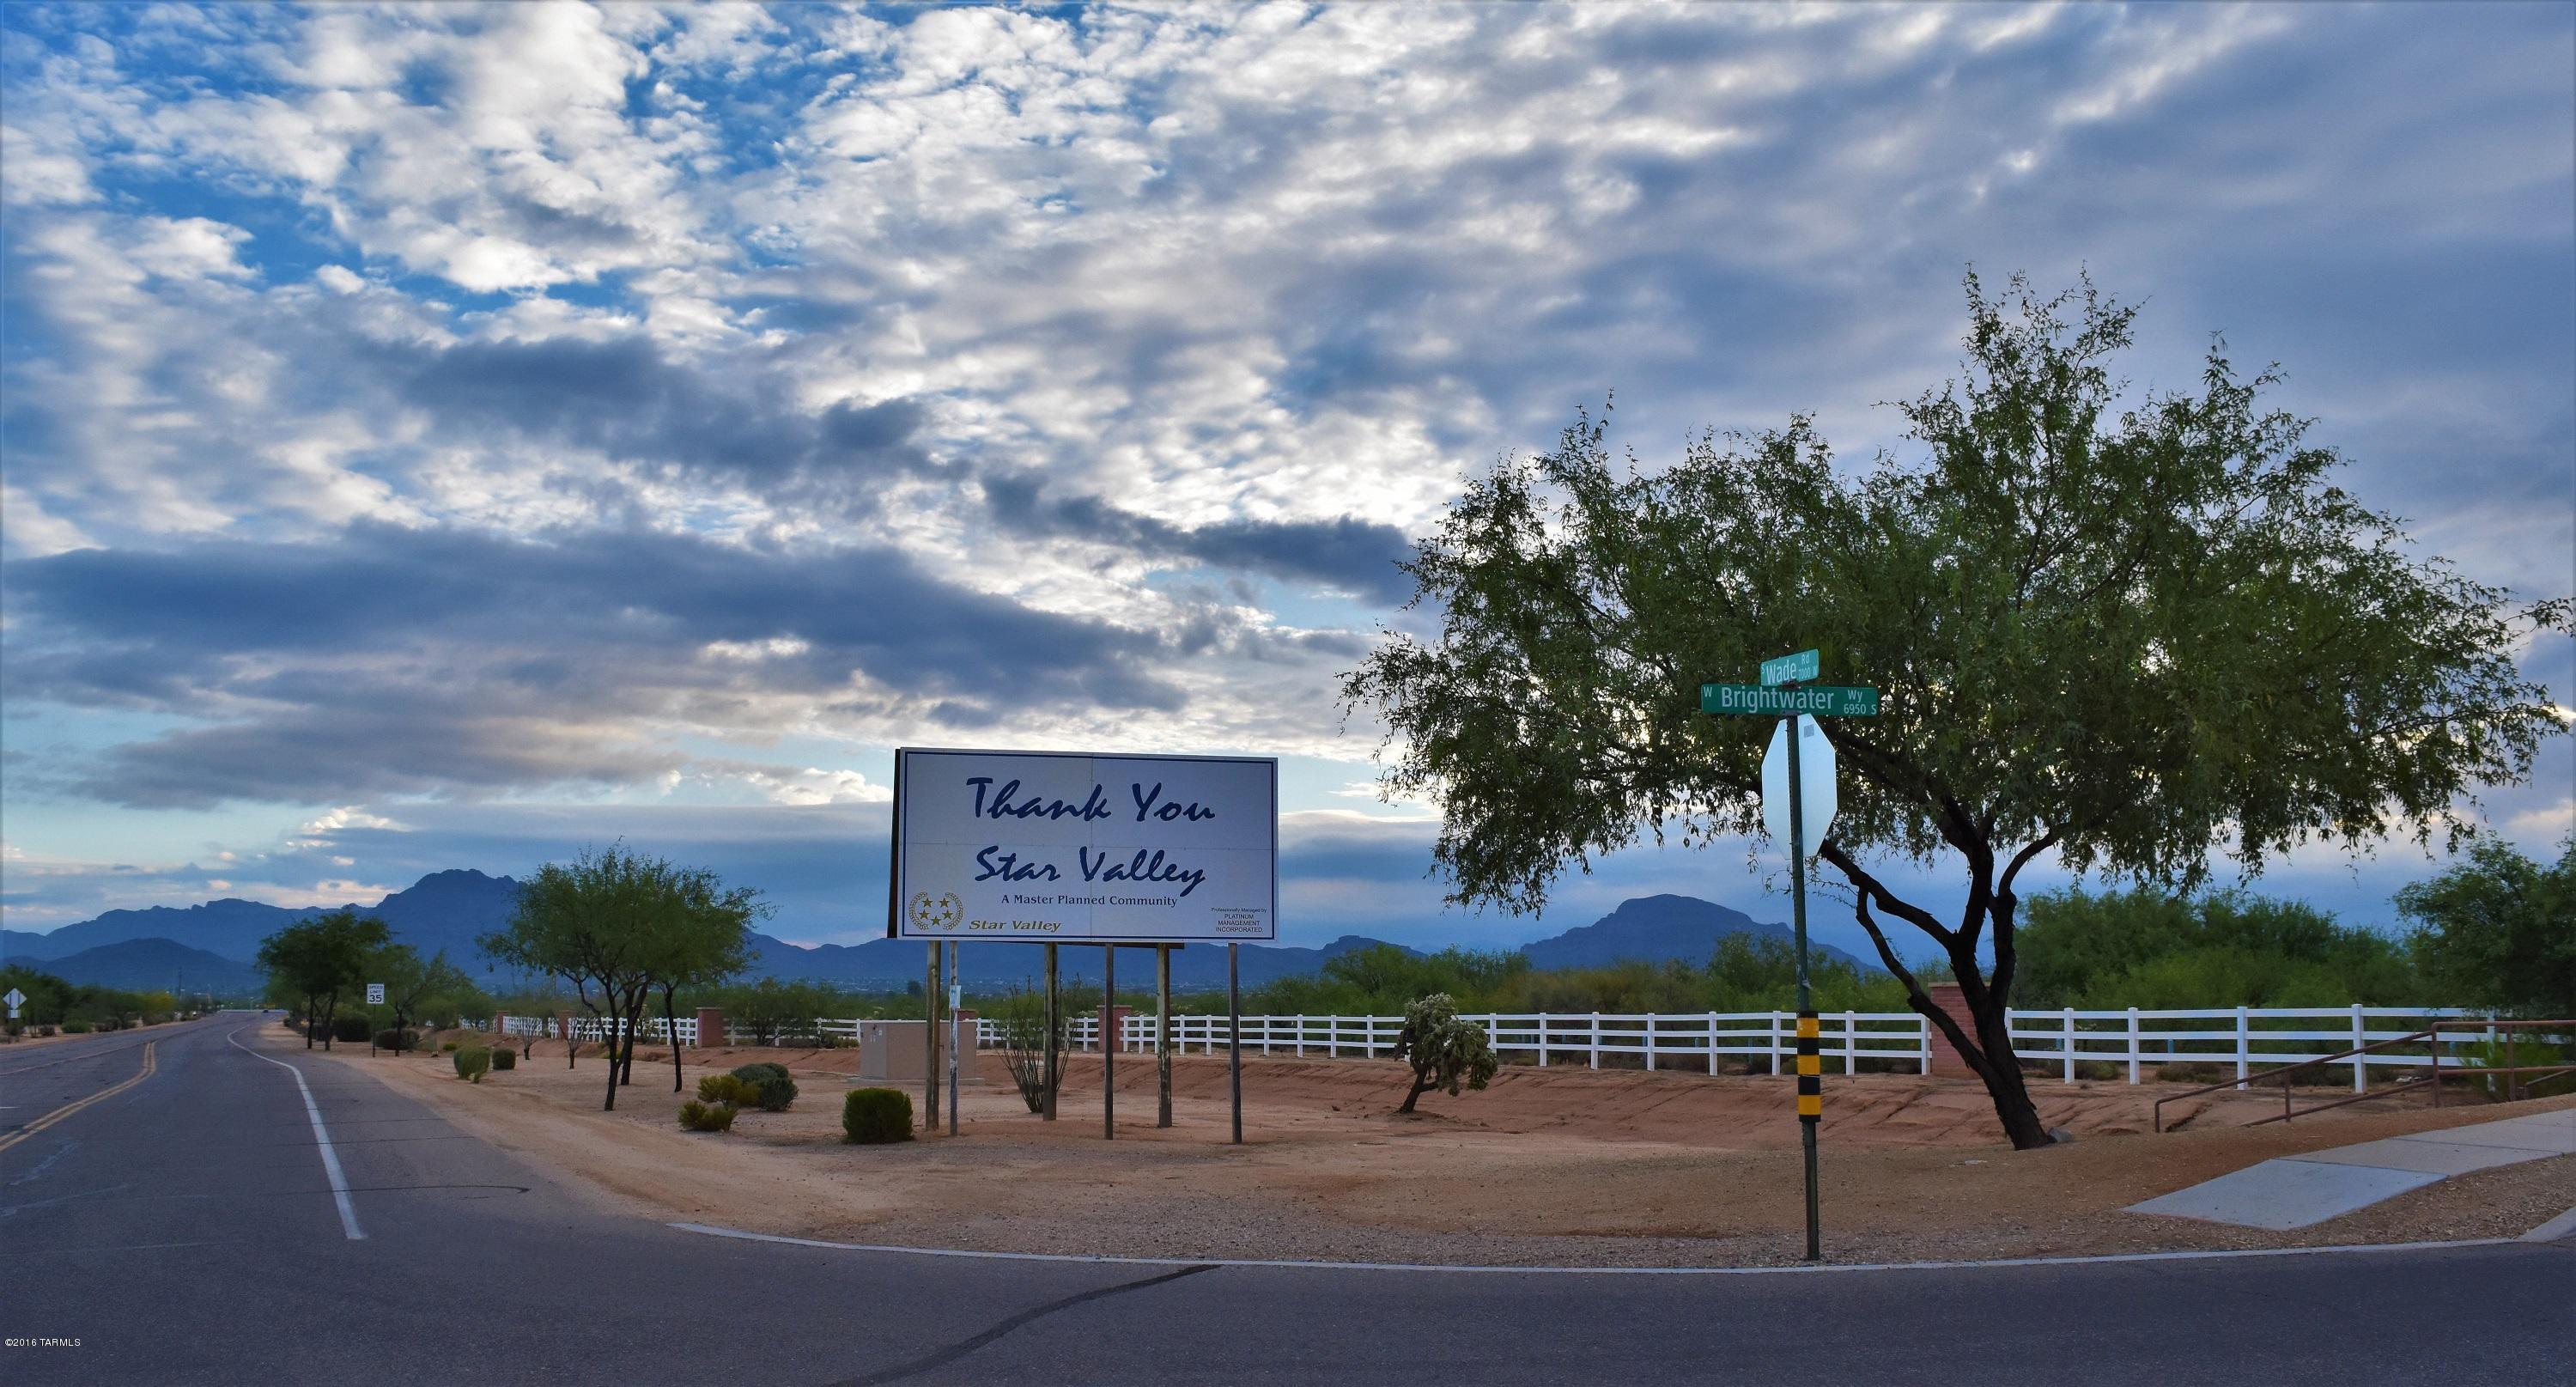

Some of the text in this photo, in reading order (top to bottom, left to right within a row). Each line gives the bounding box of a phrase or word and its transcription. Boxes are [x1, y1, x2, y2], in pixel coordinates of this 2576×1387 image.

[1760, 653, 1810, 684] S Wade Rd
[1704, 685, 1862, 714] W Brightwater Wy
[1844, 703, 1877, 715] 6950 S
[966, 776, 1216, 823] Thank You
[974, 845, 1206, 897] Star Valley
[1001, 894, 1177, 908] A Master Planned Community
[969, 920, 1061, 933] Star Valley
